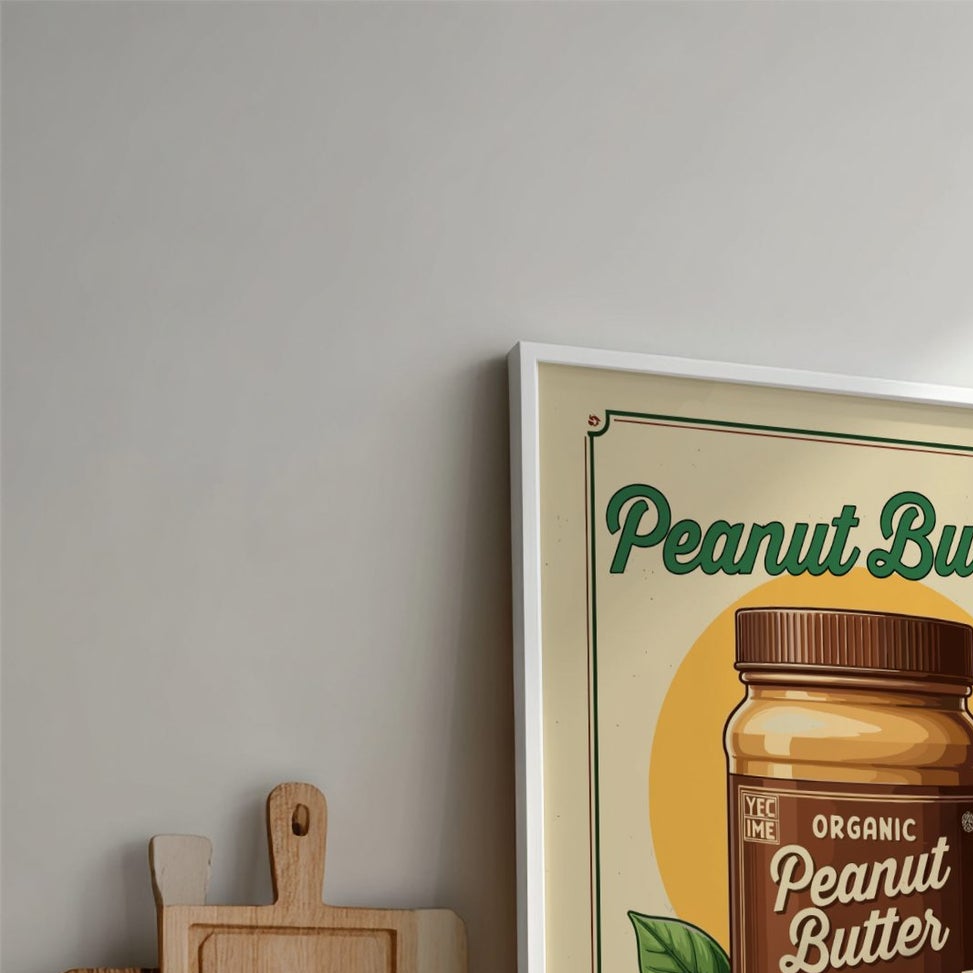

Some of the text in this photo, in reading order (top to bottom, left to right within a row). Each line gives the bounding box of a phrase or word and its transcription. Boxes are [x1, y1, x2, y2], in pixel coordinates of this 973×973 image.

[605, 483, 861, 576] Peanut
[812, 814, 916, 842] ORGANIC
[769, 836, 951, 912] Peanut
